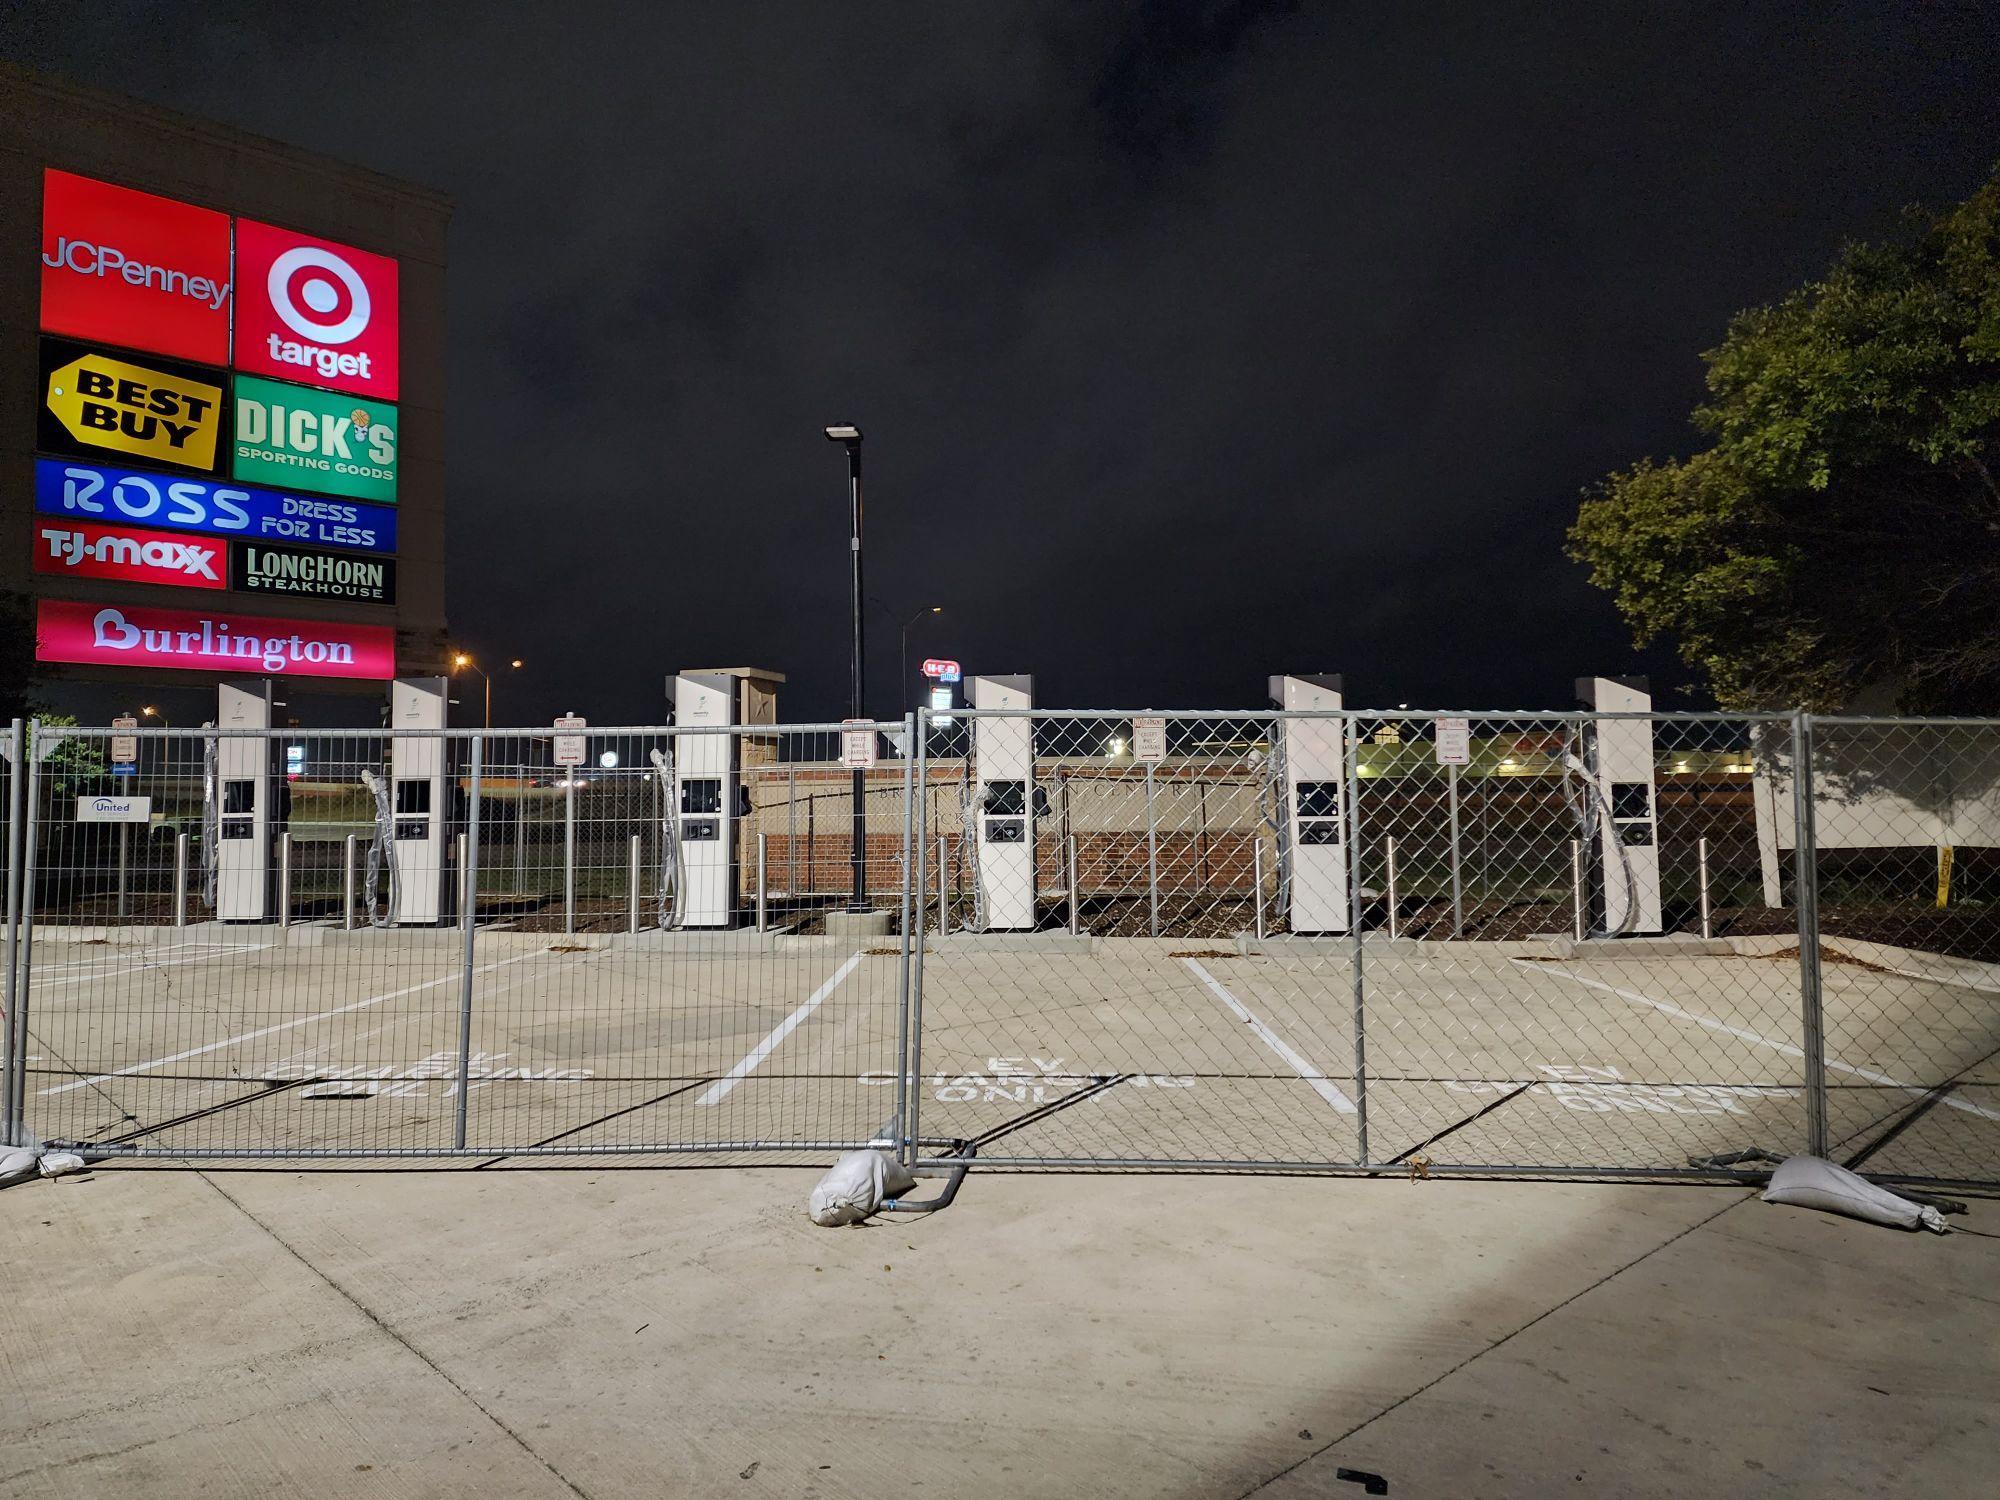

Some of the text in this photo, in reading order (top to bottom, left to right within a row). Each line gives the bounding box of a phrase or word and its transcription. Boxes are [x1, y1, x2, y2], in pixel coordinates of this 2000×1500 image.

[42, 236, 229, 310] JCPenney
[267, 333, 371, 379] target
[77, 369, 211, 423] BEST
[80, 401, 198, 448] BUY
[237, 398, 395, 465] DICK'S
[238, 447, 393, 481] SPORTING GOODS
[63, 468, 250, 529] ROSS
[283, 498, 358, 523] DRESS
[262, 516, 376, 546] FOR LESS
[247, 548, 383, 587] LONGHORN
[247, 577, 383, 598] STEAKHOUSE
[93, 608, 355, 671] Burlington
[96, 803, 130, 812] United
[987, 1057, 1065, 1071] EV
